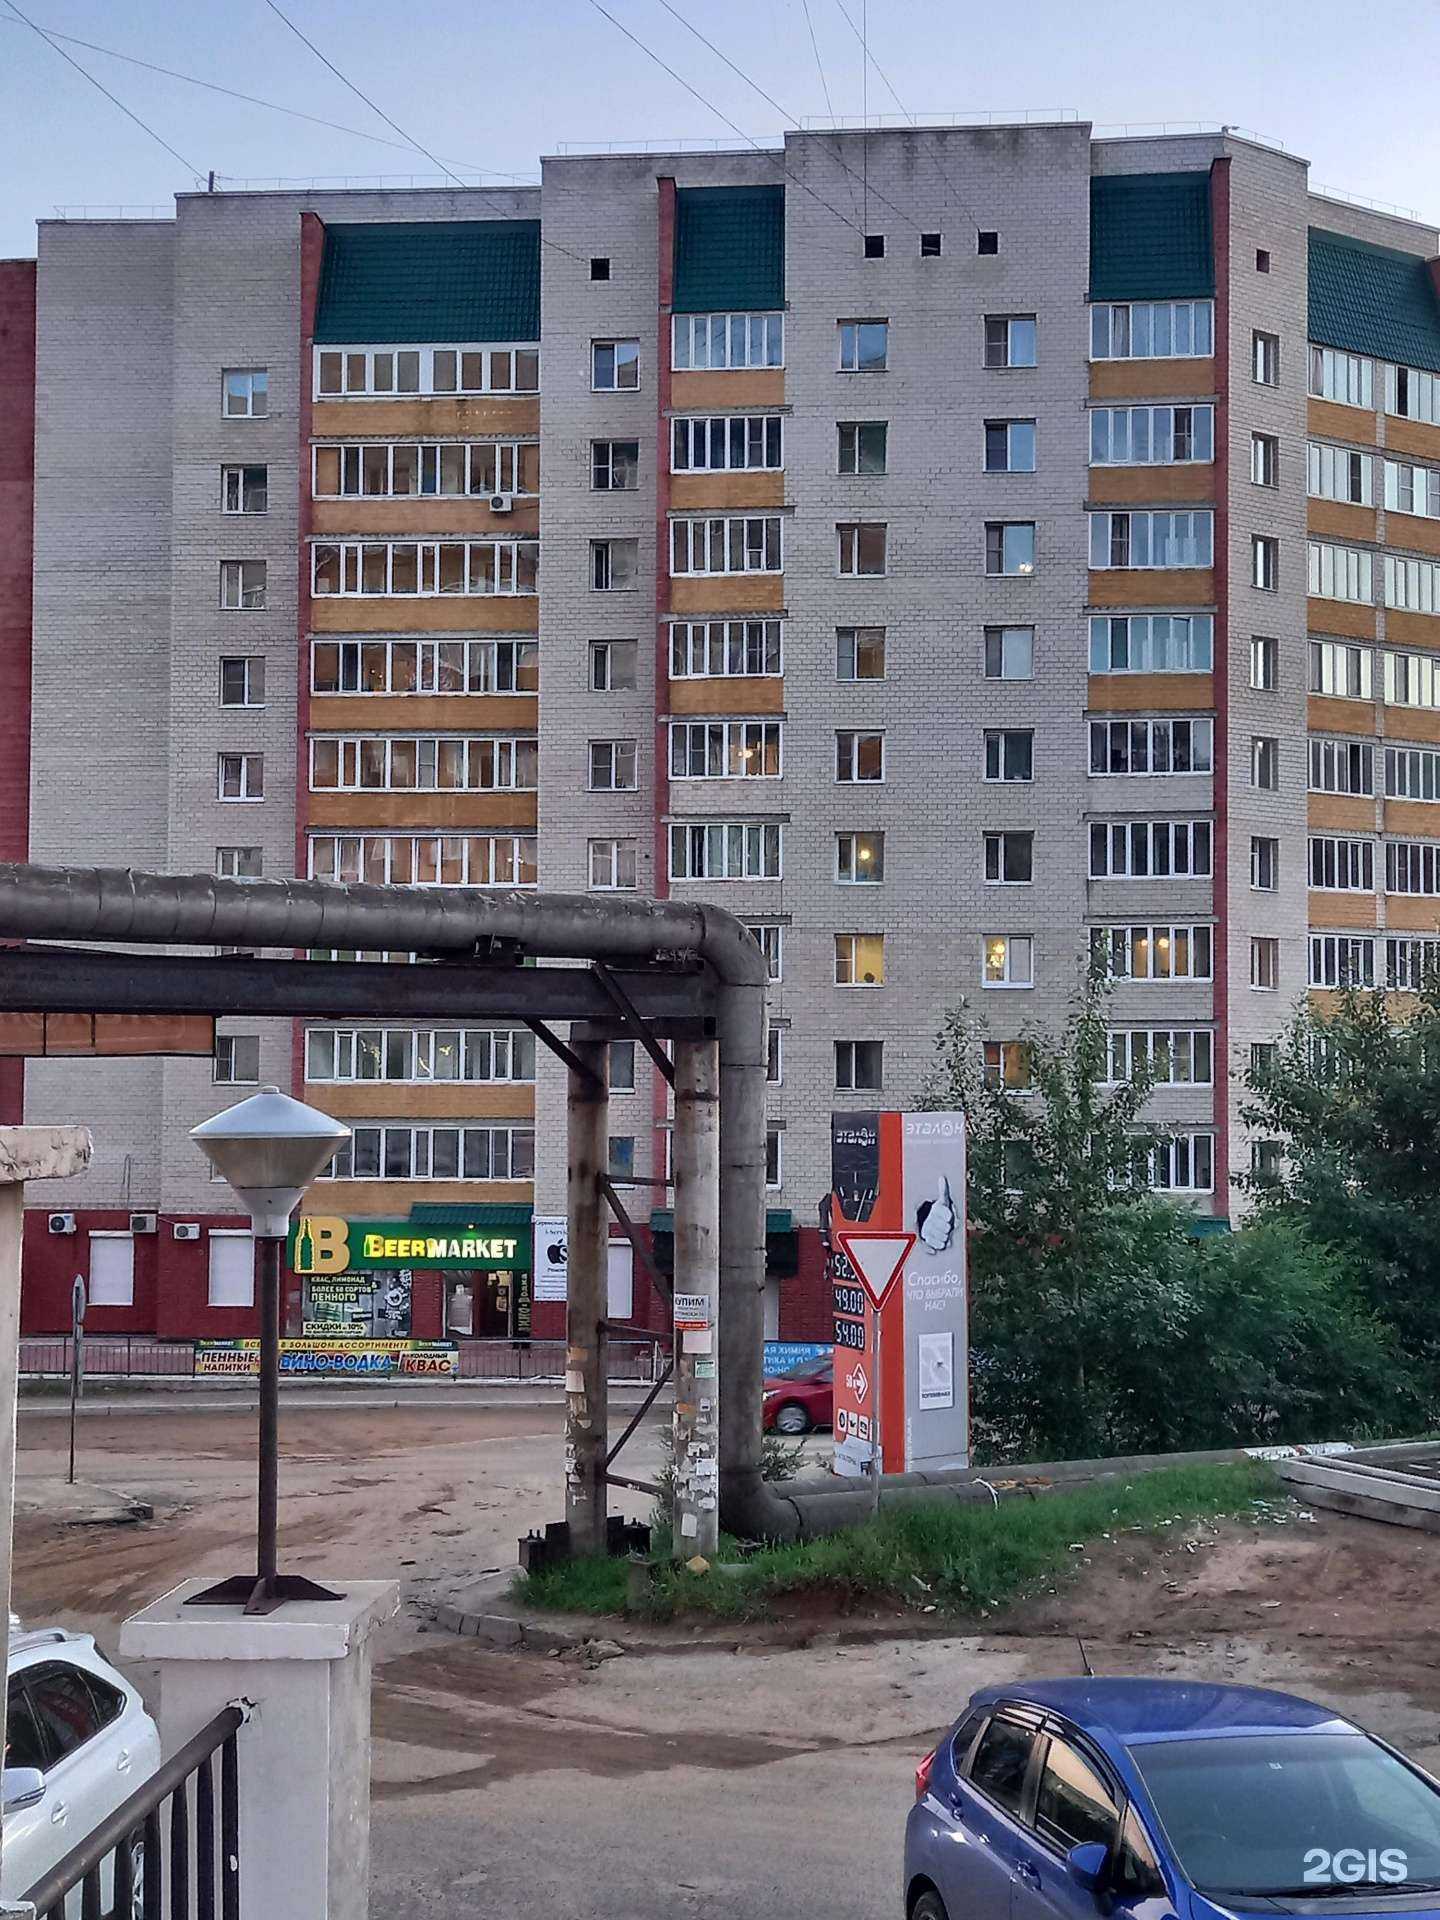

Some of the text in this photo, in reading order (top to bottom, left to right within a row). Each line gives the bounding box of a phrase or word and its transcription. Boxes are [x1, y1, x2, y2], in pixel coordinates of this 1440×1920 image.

[363, 1234, 517, 1258] BEERMARKET
[312, 1293, 357, 1301] ПЕННОГО
[835, 1289, 864, 1314] 49.00
[305, 1323, 342, 1331] СКИДКИ
[835, 1321, 864, 1348] 54.00
[338, 1341, 408, 1349] АССОРТИМЕНТЕ
[201, 1352, 255, 1362] ПЕННЫЕ
[279, 1352, 392, 1371] ВИНО-ВОДКА
[203, 1363, 251, 1371] НАПИТКИ
[405, 1359, 451, 1372] КВАС
